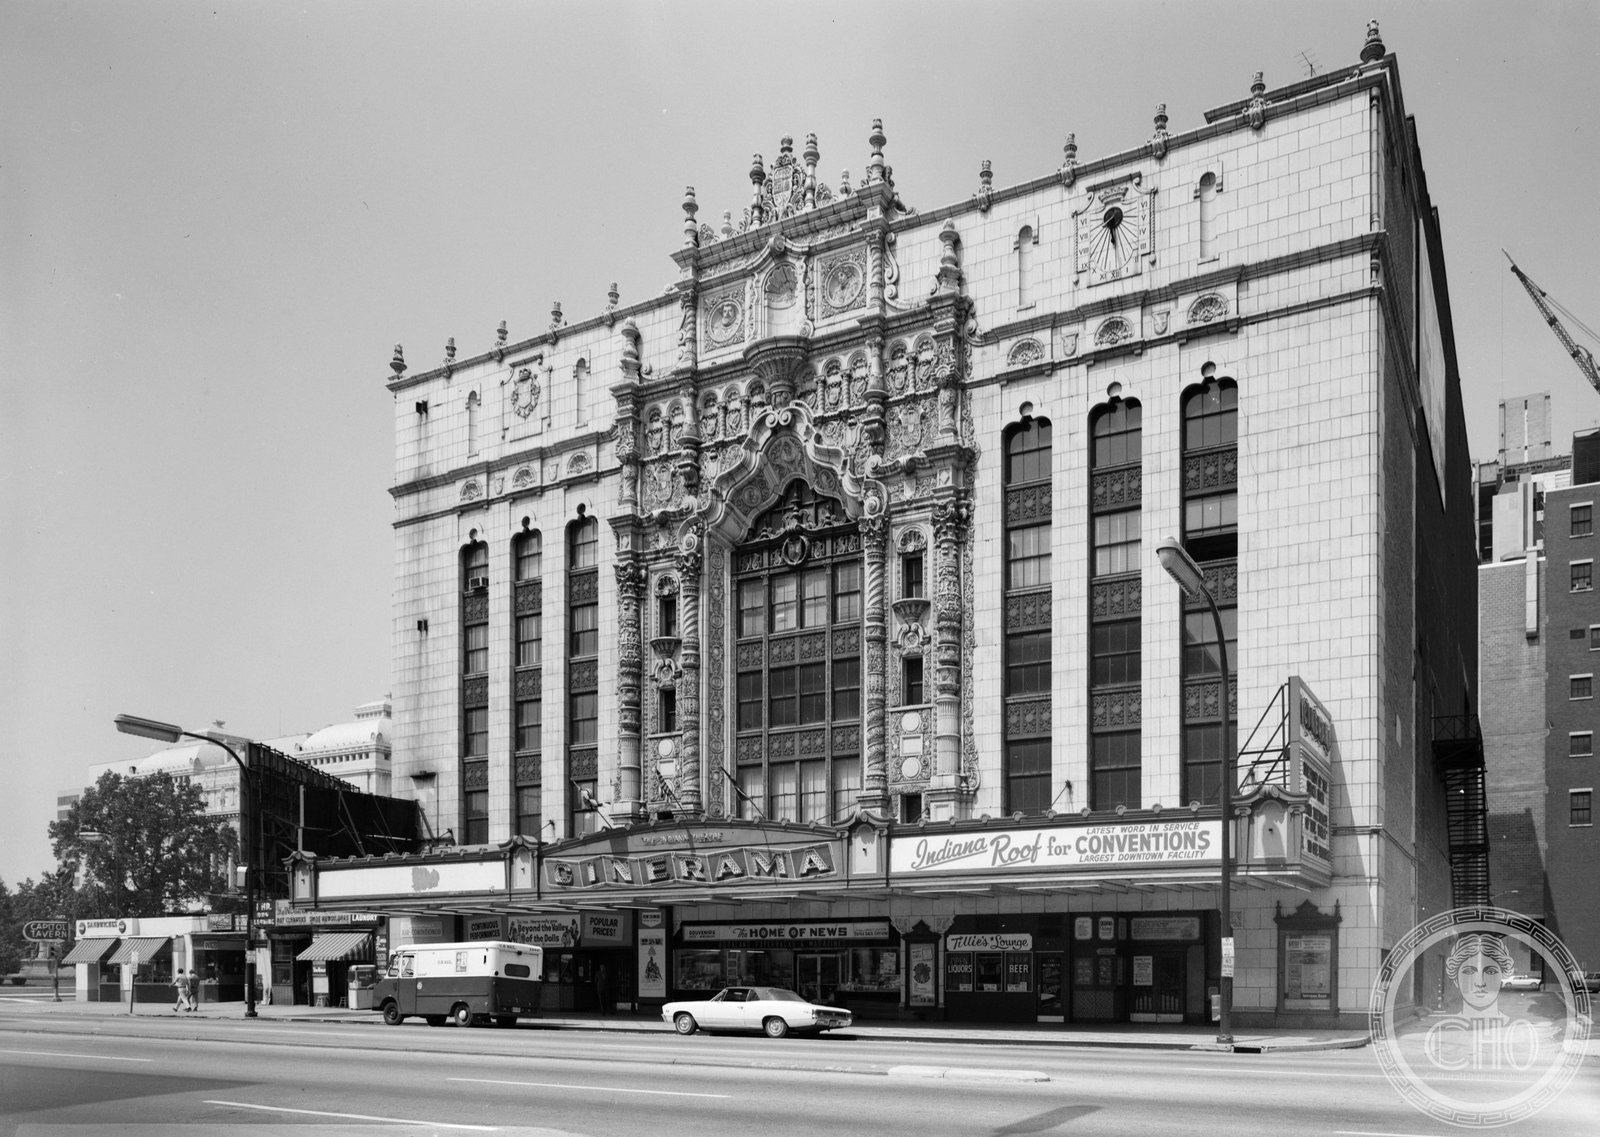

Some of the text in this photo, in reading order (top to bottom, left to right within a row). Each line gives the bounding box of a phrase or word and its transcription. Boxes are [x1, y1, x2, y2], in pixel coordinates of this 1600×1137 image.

[1079, 232, 1089, 240] VII
[1139, 228, 1147, 236] IV
[1079, 247, 1090, 255] VIII
[1110, 271, 1120, 279] XII
[1086, 822, 1200, 835] LATEST WORD IN SERVICE
[911, 830, 1211, 870] Indiana Roof for CONVENTIONS
[1079, 850, 1207, 863] LARGEST DOWNTOWN FACILITY
[553, 849, 832, 886] CINERAMA
[590, 917, 618, 927] POPULAR
[30, 923, 66, 931] CAPITOL
[518, 924, 541, 934] Beyond
[541, 923, 552, 932] the
[592, 926, 616, 937] PRICES!
[30, 930, 67, 938] TAVERN
[733, 926, 848, 938] The HOME OF NEWS
[525, 934, 560, 942] of the Dolls
[951, 934, 1028, 950] Tillie's Lounge
[947, 964, 972, 973] LIQUORS
[1009, 964, 1029, 973] BEER
